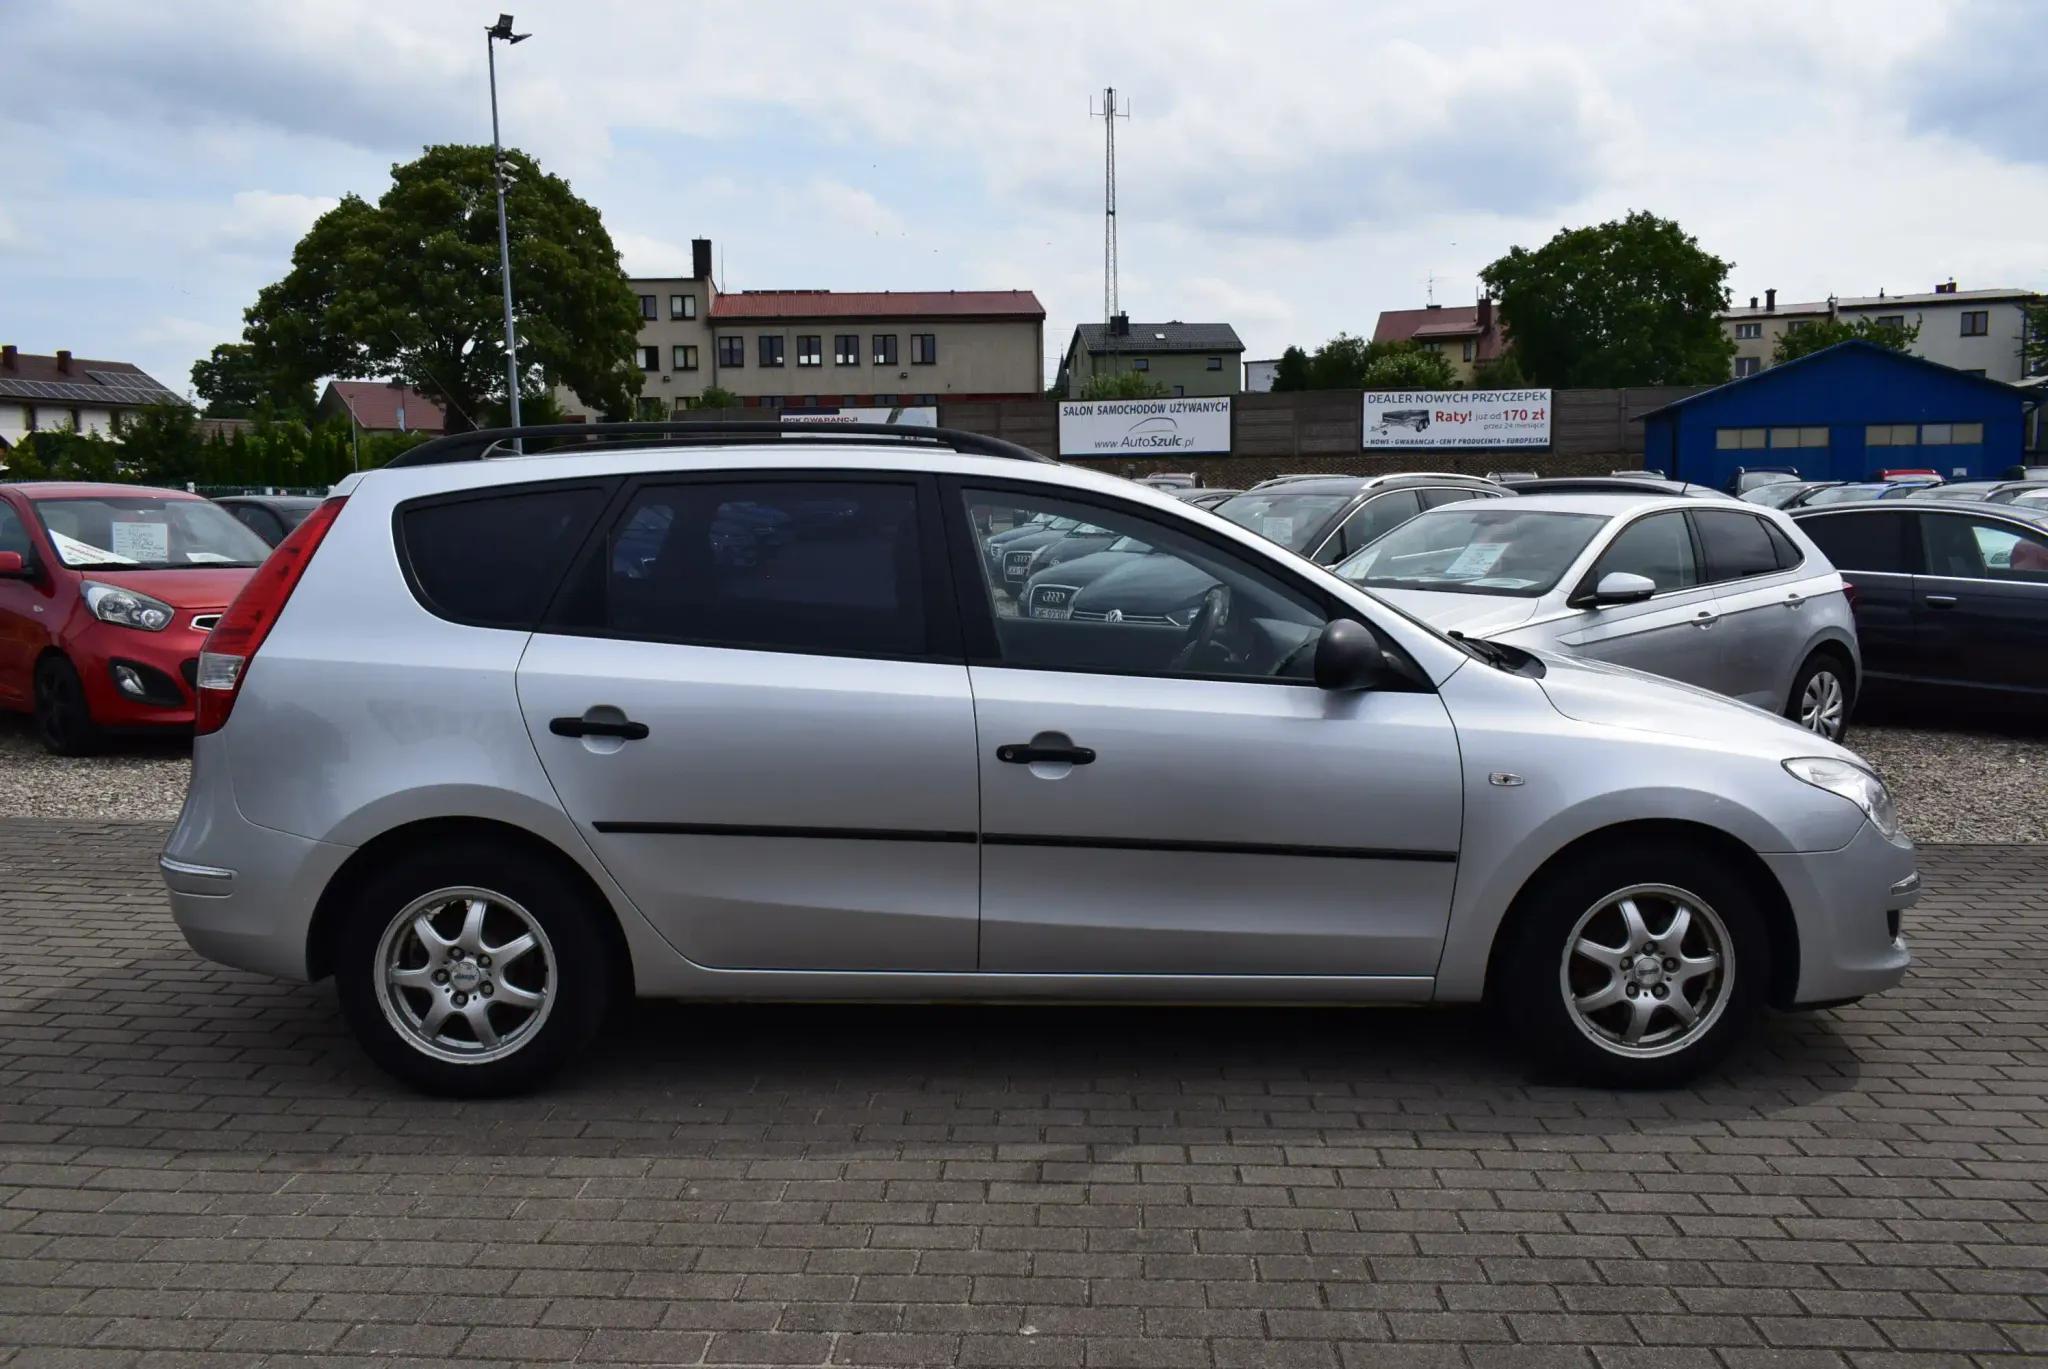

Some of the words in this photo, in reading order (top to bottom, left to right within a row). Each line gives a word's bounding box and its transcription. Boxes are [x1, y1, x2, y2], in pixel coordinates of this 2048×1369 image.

[1368, 394, 1412, 404] DEALER
[1415, 393, 1469, 403] NOWYCH
[1472, 391, 1548, 402] PRZYCZEPEK
[1063, 406, 1094, 417] SALON
[1097, 402, 1166, 416] SAMOCHODÓW
[1169, 401, 1229, 413] UŻYWANYCH
[1435, 410, 1473, 424] Raty!
[1503, 409, 1528, 421] 170
[1532, 407, 1545, 420] zł
